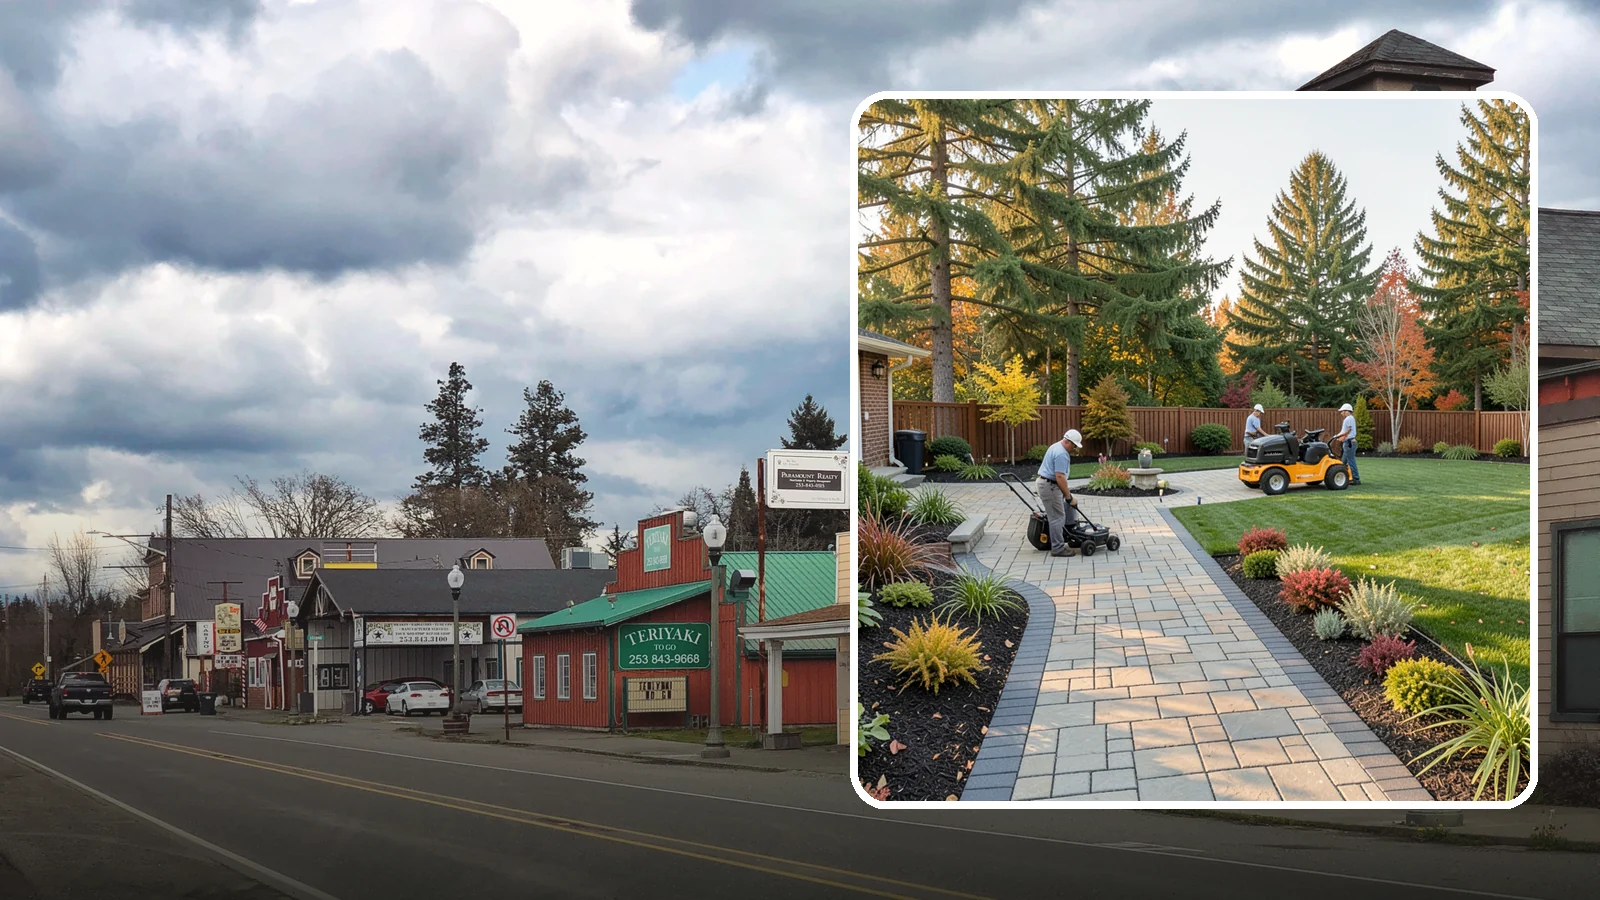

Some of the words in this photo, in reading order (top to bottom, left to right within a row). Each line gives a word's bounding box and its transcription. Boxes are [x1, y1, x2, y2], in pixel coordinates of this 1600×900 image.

[781, 471, 815, 479] PARAMOUNT
[817, 472, 839, 480] REALTY
[624, 627, 702, 646] TERIYAKI
[653, 643, 665, 651] TO
[665, 643, 677, 651] GO
[628, 654, 649, 665] 253
[651, 653, 700, 664] 843-9668
